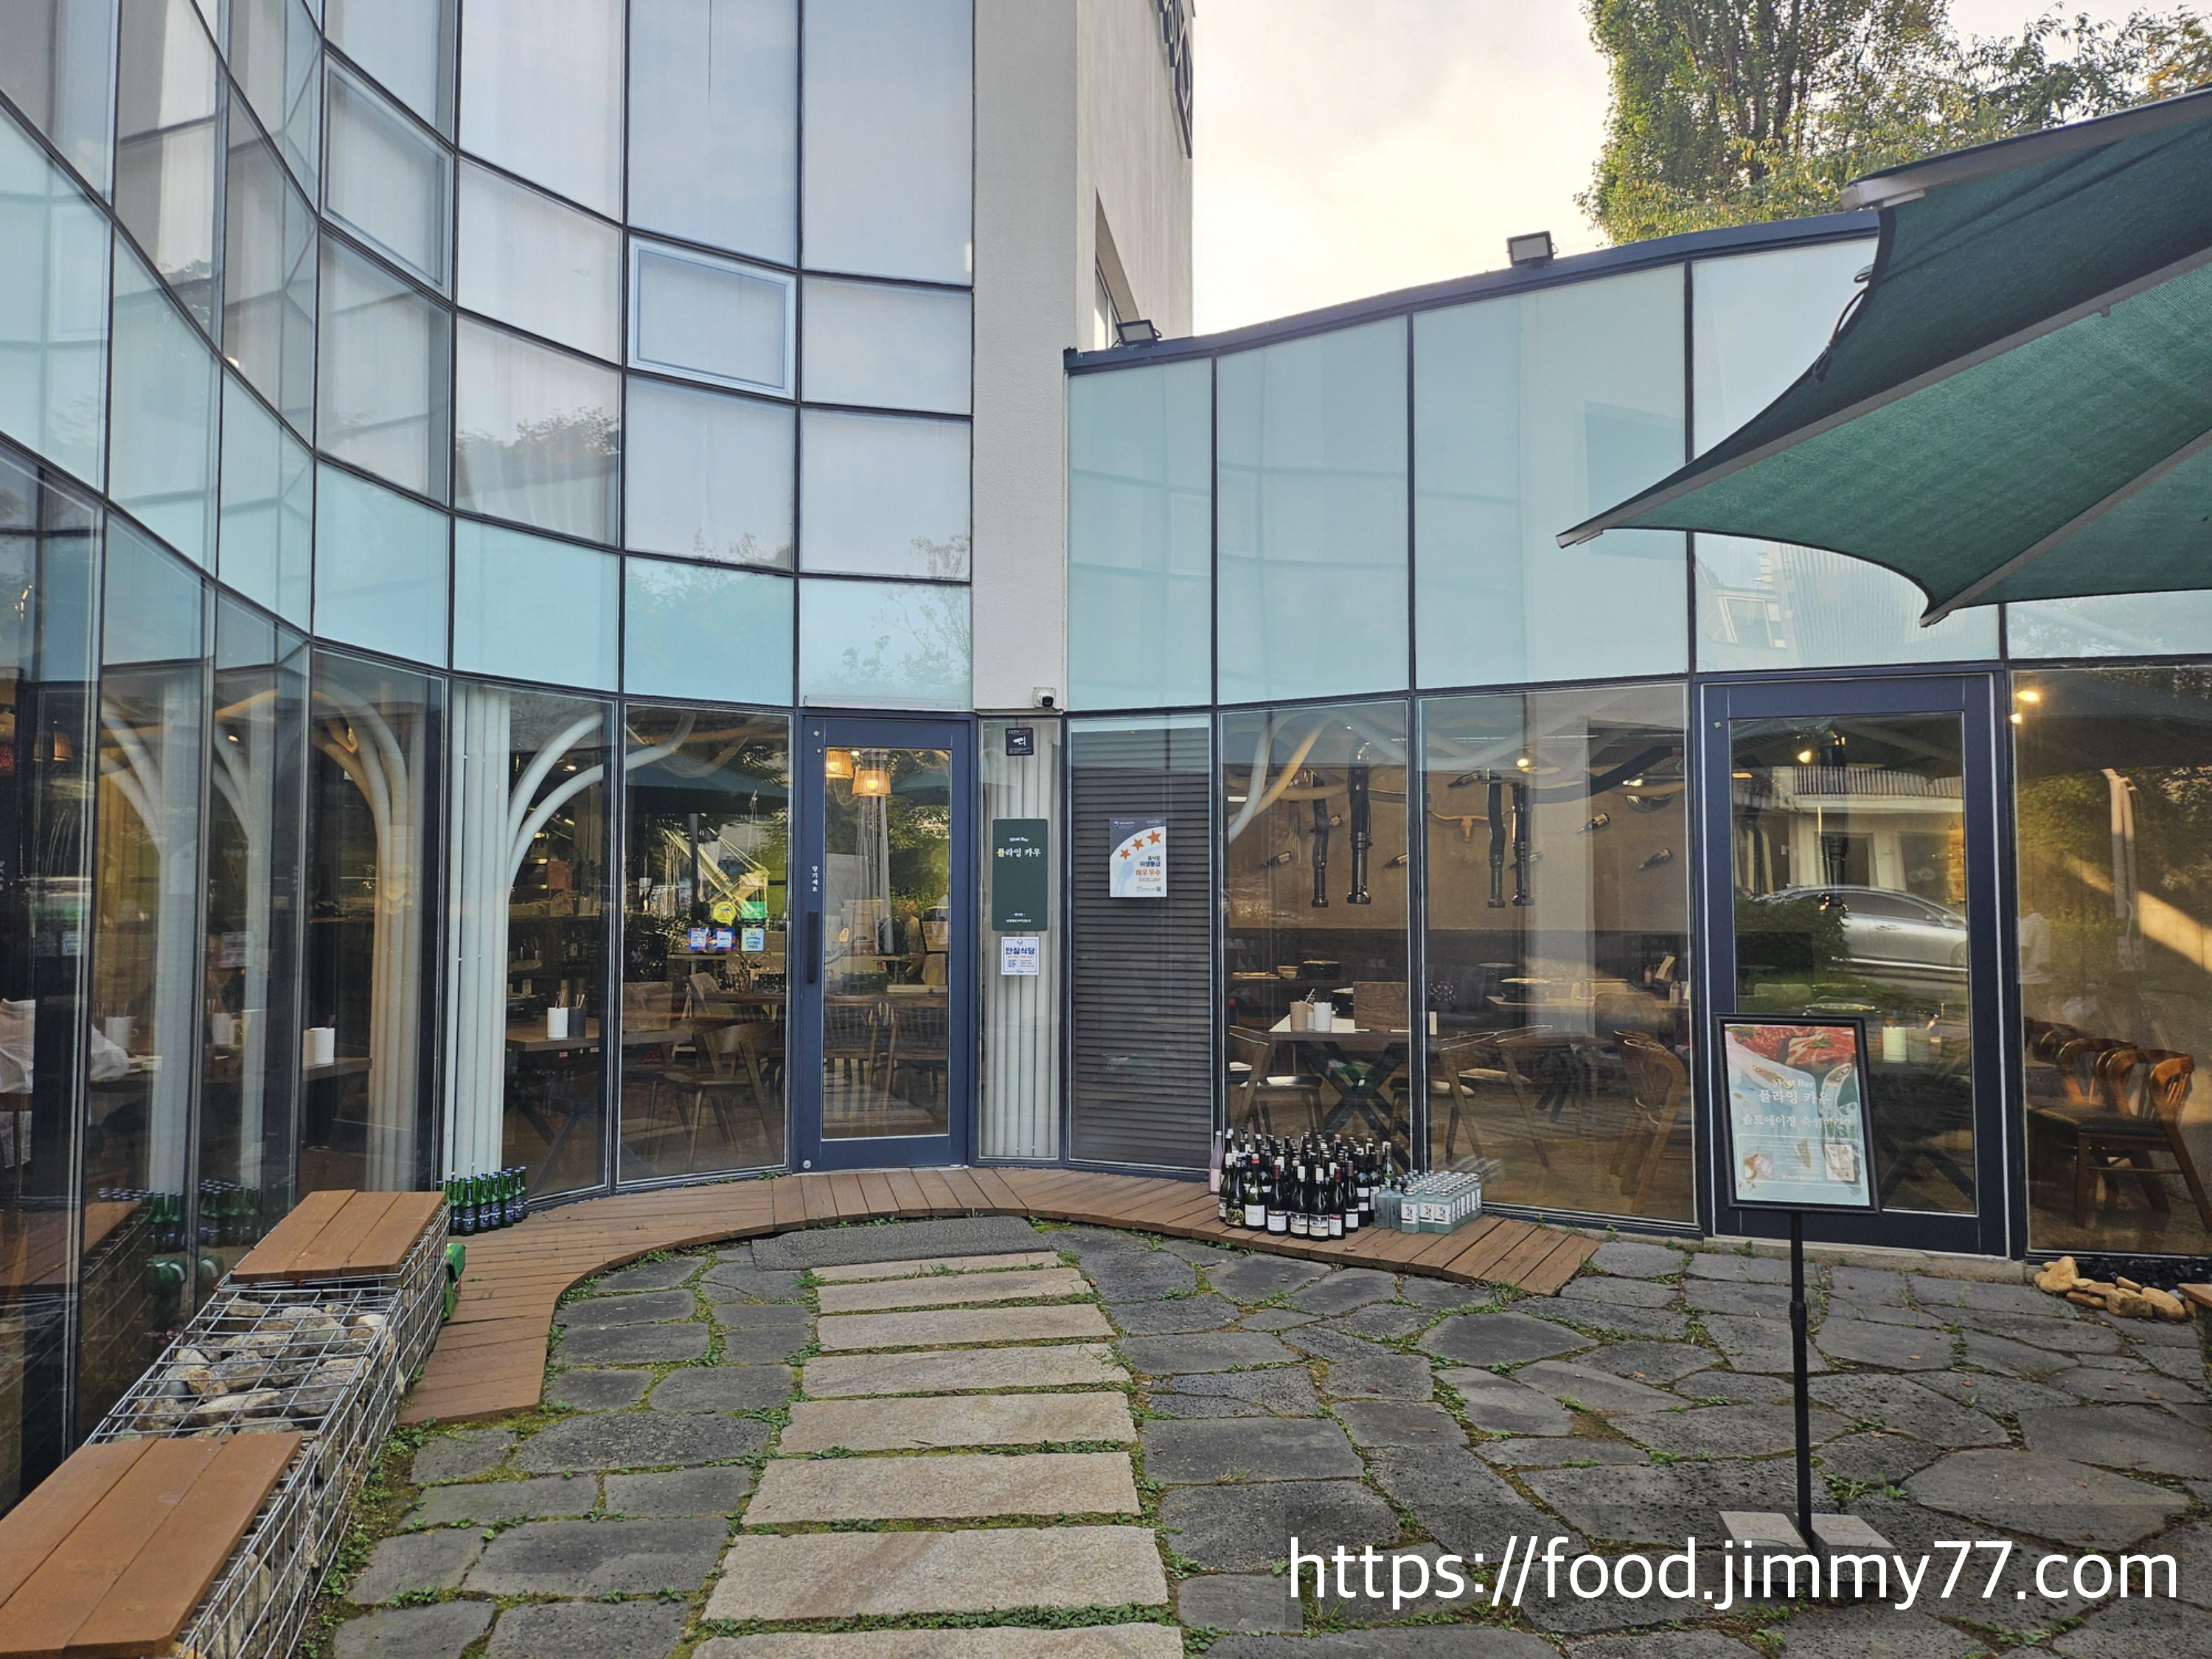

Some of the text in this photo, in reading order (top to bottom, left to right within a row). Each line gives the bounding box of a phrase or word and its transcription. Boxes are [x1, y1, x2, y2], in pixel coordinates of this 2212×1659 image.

[997, 847, 1042, 858] 플라잉 카우
[1135, 869, 1161, 877] 매우 우수
[1005, 947, 1035, 955] 안심식당
[1798, 1079, 1815, 1088] Bar
[1759, 1089, 1831, 1106] 플라잉 카우
[1742, 1114, 1796, 1127] 솔트에이징
